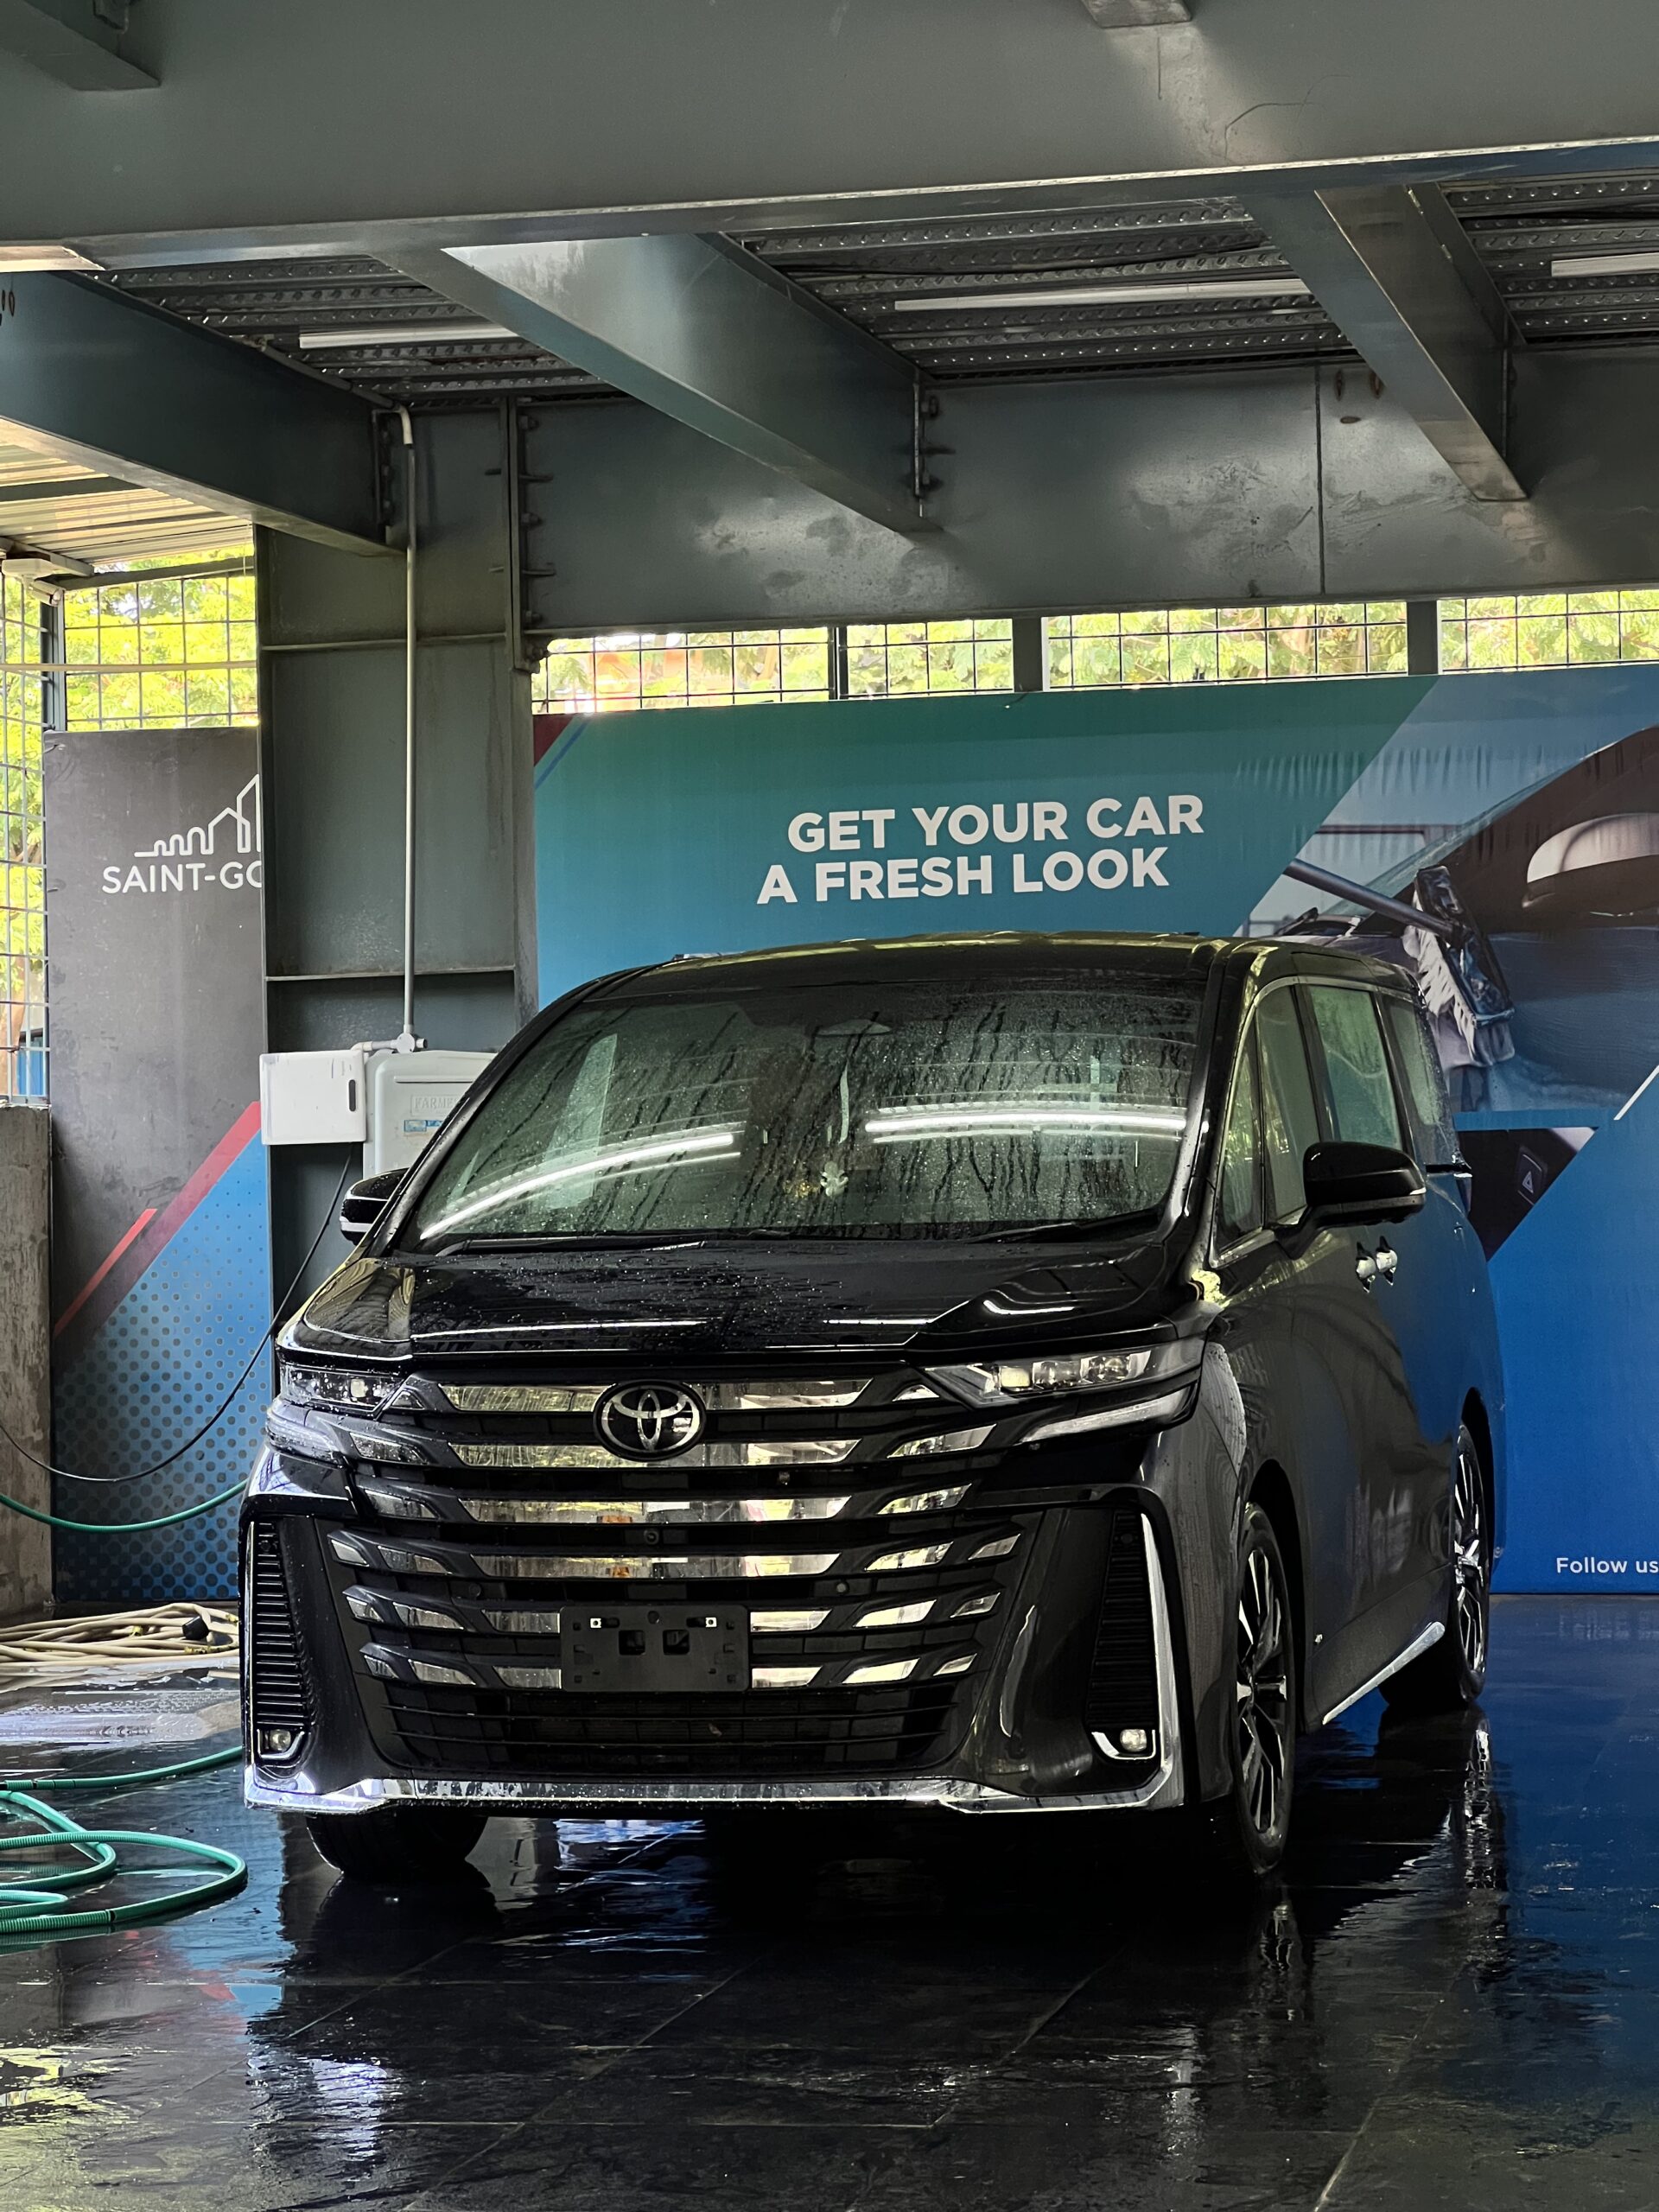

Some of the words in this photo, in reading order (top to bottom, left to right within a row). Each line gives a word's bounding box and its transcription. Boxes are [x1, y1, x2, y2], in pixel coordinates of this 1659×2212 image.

[787, 810, 896, 853] GET
[911, 802, 1069, 846] YOUR
[1086, 794, 1205, 839] CAR
[756, 864, 798, 905] A
[815, 855, 993, 902] FRESH
[1013, 847, 1170, 893] LOOK
[1556, 1556, 1628, 1573] Follow
[1636, 1560, 1659, 1573] us
